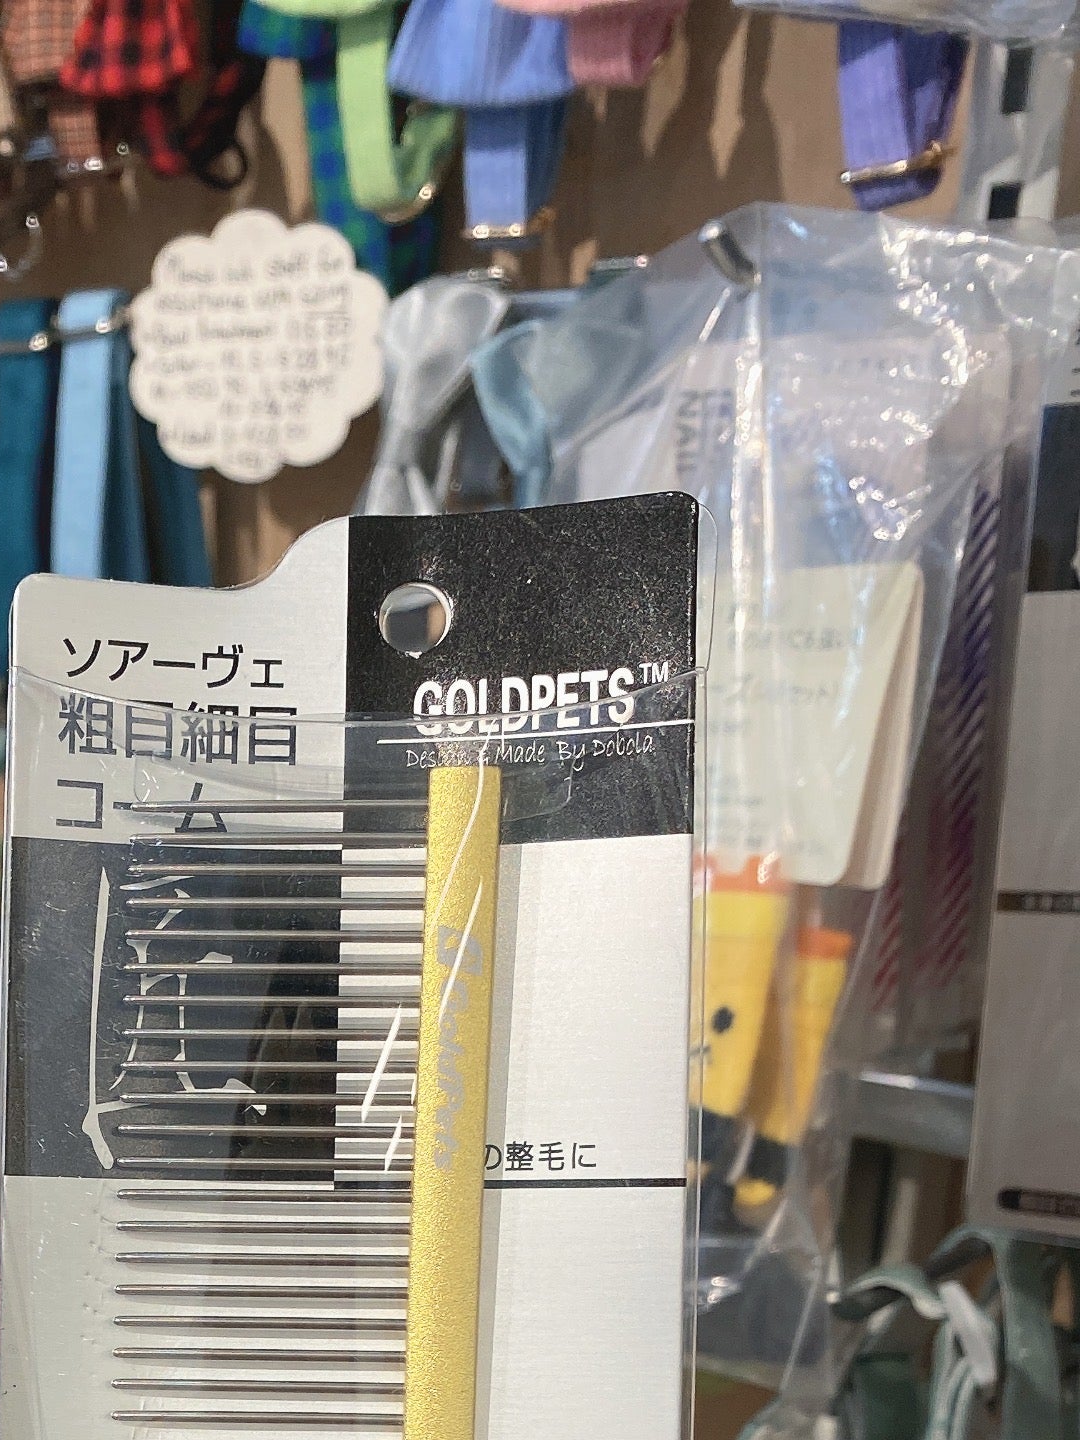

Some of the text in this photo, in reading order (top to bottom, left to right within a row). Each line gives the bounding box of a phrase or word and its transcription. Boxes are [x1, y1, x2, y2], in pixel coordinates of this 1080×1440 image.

[62, 638, 285, 689] ソアーヴェ
[58, 692, 298, 766] 粗目細目
[556, 740, 586, 772] By
